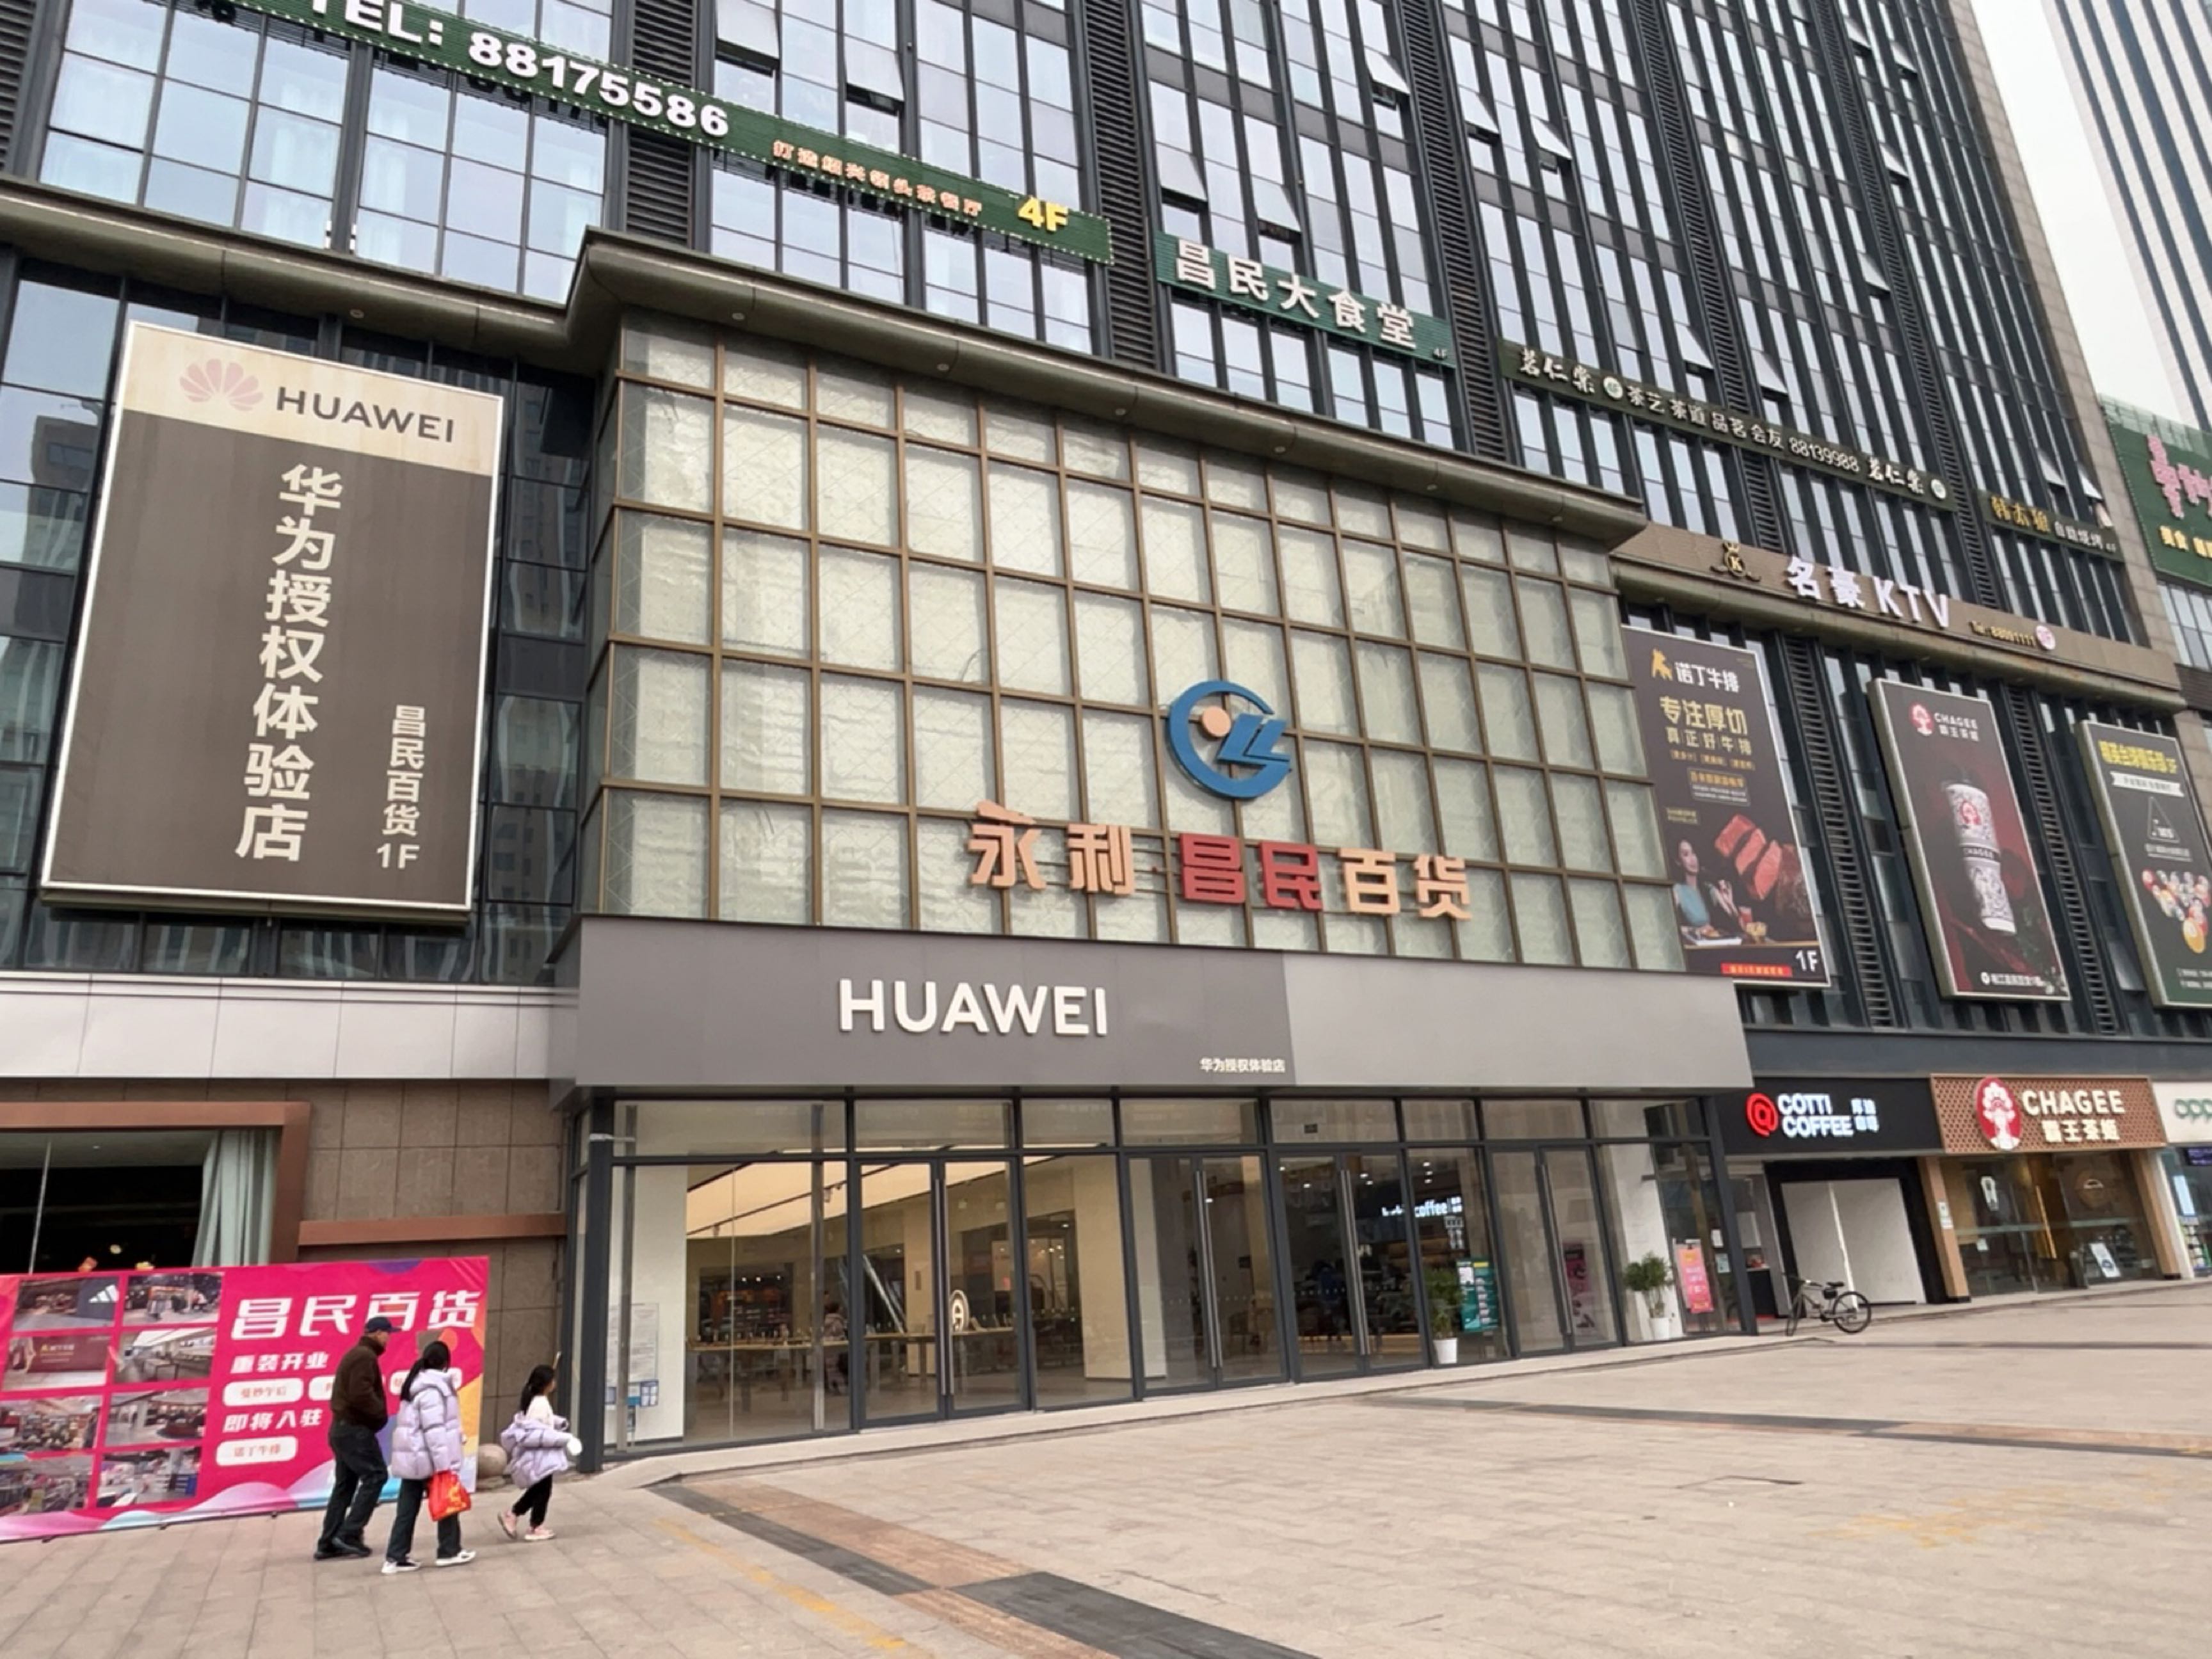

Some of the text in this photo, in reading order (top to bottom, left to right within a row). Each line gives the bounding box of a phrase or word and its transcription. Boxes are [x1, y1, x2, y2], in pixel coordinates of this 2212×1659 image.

[469, 31, 728, 138] 88175586
[1018, 196, 1070, 232] 4F
[1176, 237, 1416, 349] 昌民大食堂
[276, 386, 455, 443] HUAWEI
[1789, 437, 1859, 472] 88139988
[235, 464, 343, 862] 华为授权体验店
[1659, 695, 1748, 735] 专注厚切
[1934, 712, 1978, 729] CHAGEE
[1665, 726, 1752, 756] 真正好牛排
[377, 705, 426, 869] 昌民百货 1F
[1795, 950, 1818, 972] 1F
[839, 979, 1107, 1037] HUAWEI
[1199, 1057, 1286, 1073] 华为授权体验店
[1777, 1093, 1832, 1116] COTTI
[2023, 1090, 2126, 1116] CHAGEE
[1782, 1116, 1854, 1138] COFFEE
[231, 1290, 481, 1340] 昌民百货
[230, 1351, 329, 1374] 重装开业
[222, 1409, 323, 1433] 即将入驻
